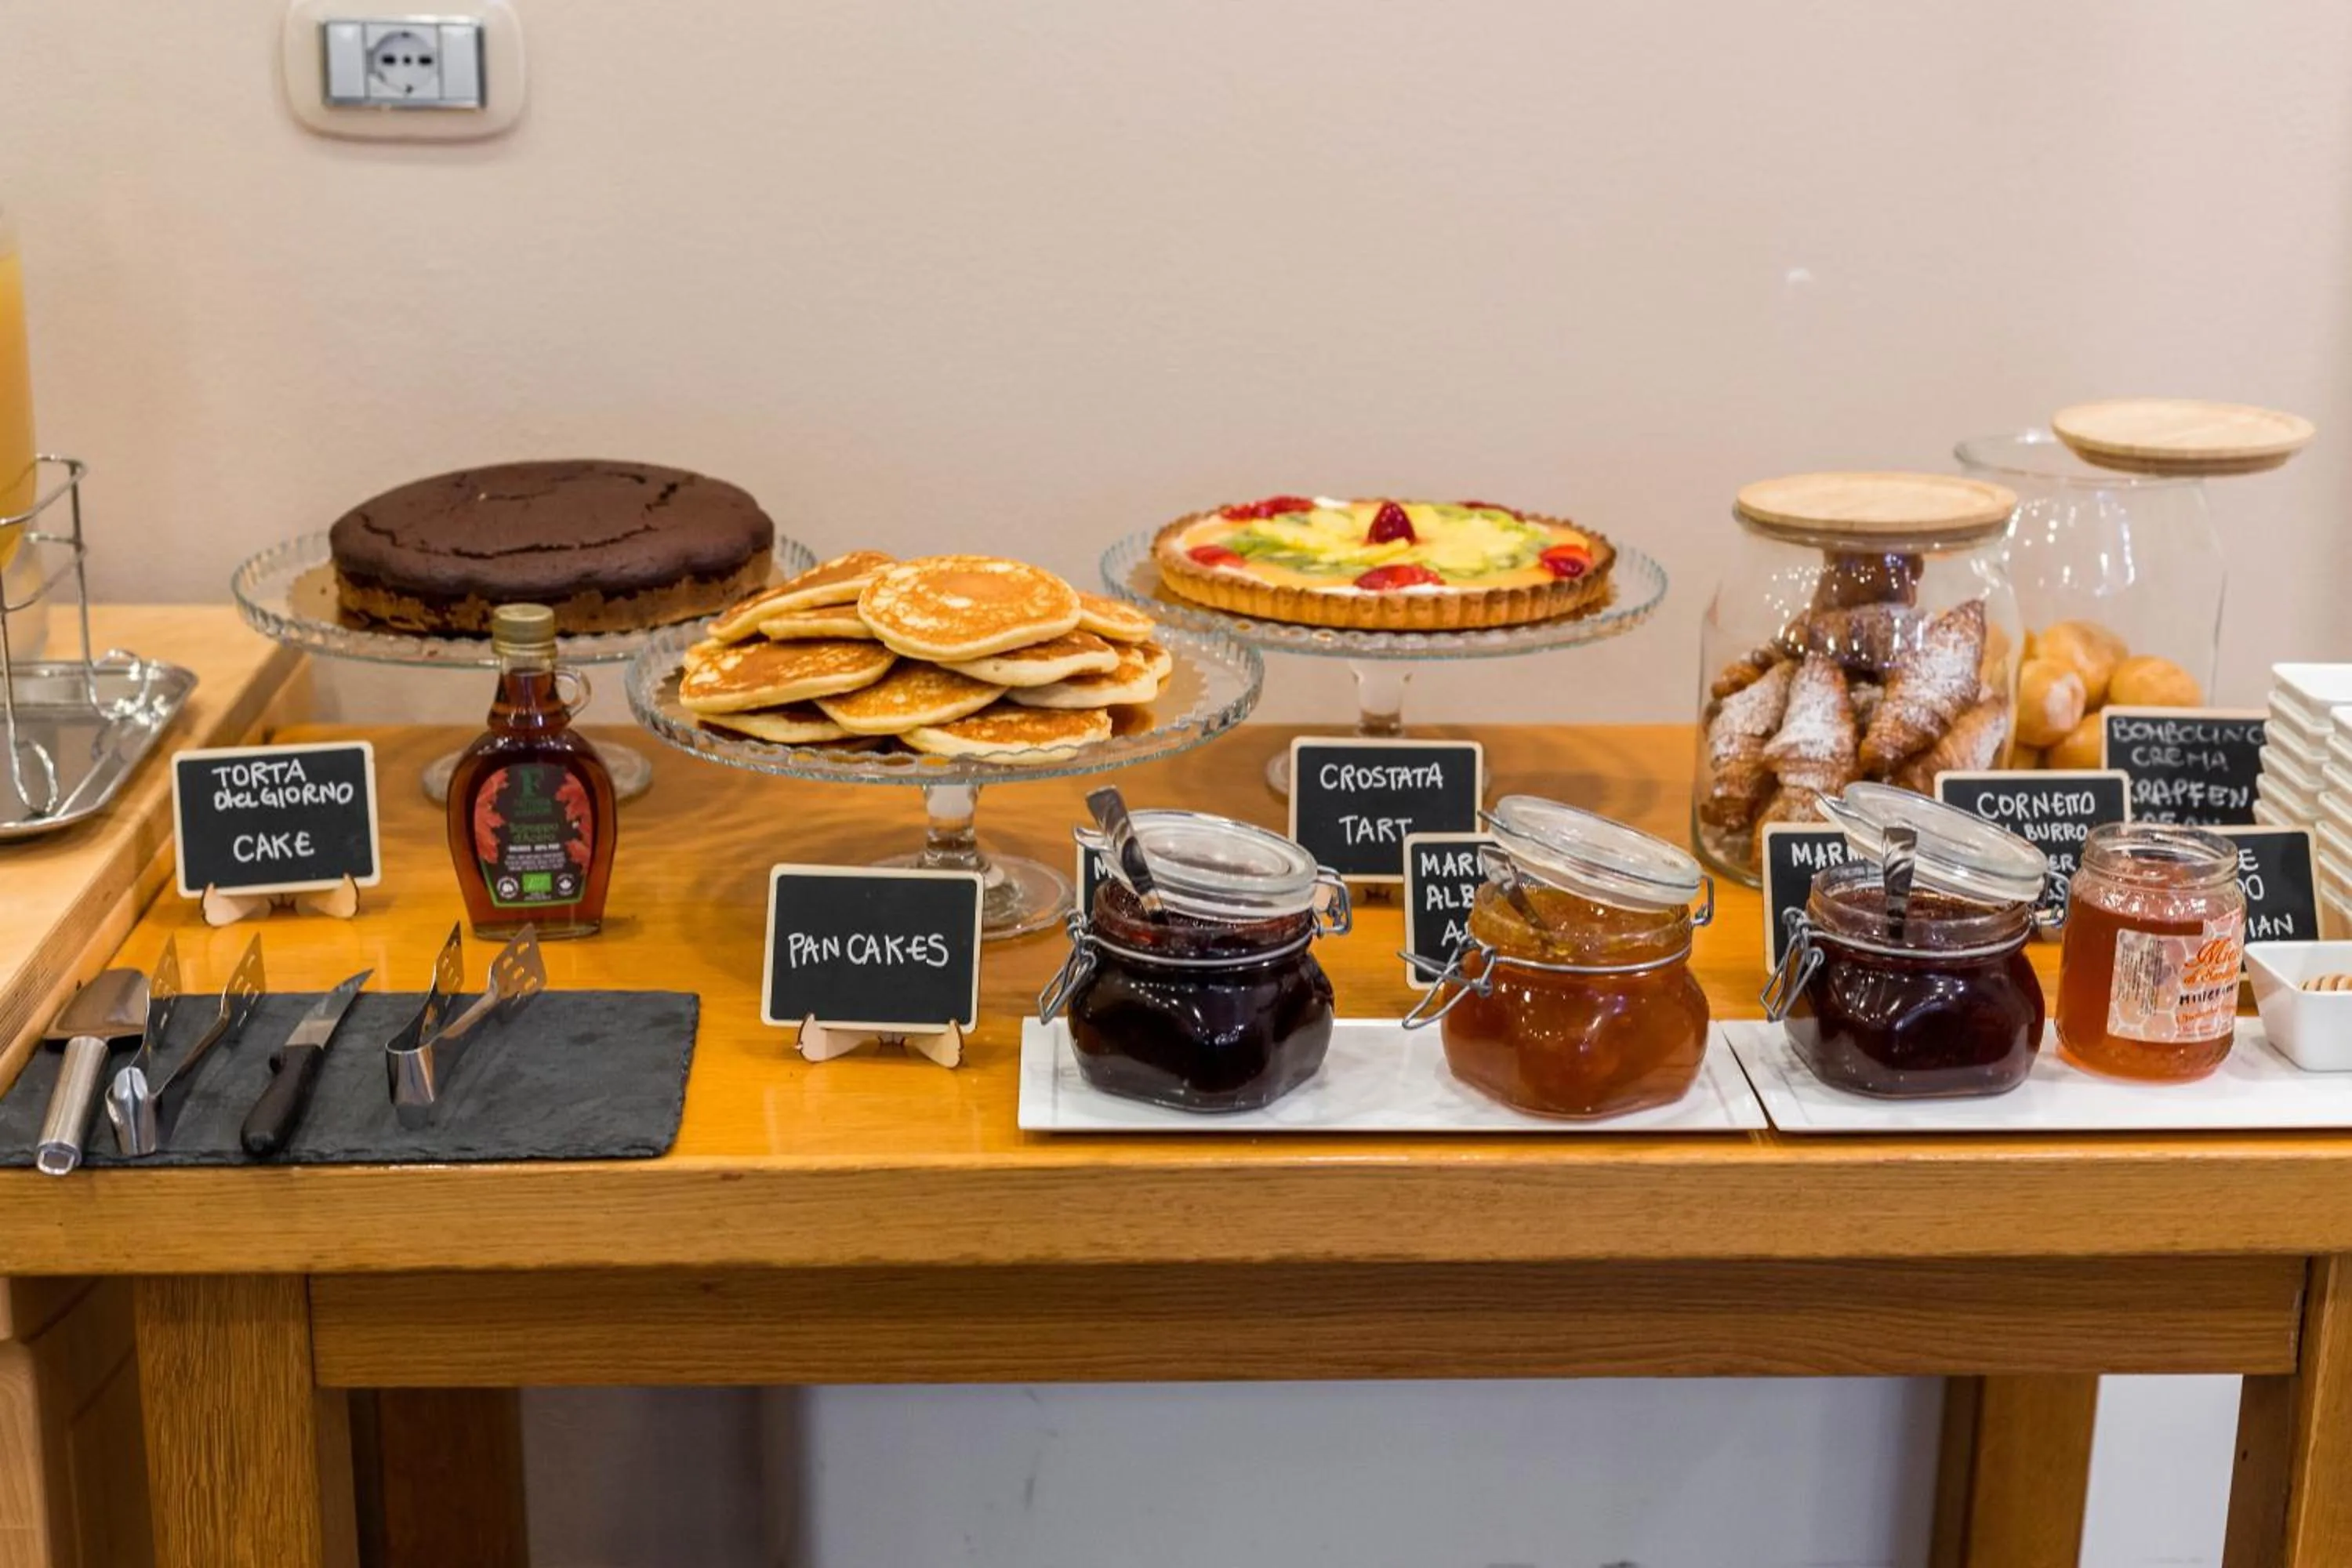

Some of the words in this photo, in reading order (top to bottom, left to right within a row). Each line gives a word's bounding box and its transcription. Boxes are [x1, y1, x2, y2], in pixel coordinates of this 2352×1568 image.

[212, 757, 307, 789] TORTA
[2131, 746, 2230, 772] CREMA
[1319, 761, 1444, 793] CROSTATA
[260, 782, 354, 809] GIORNO
[1976, 791, 2096, 821] CORNETTO
[1339, 815, 1413, 846] TART
[2023, 822, 2088, 843] BURRO
[233, 831, 315, 862] CAKE
[788, 932, 949, 969] PANCAKES
